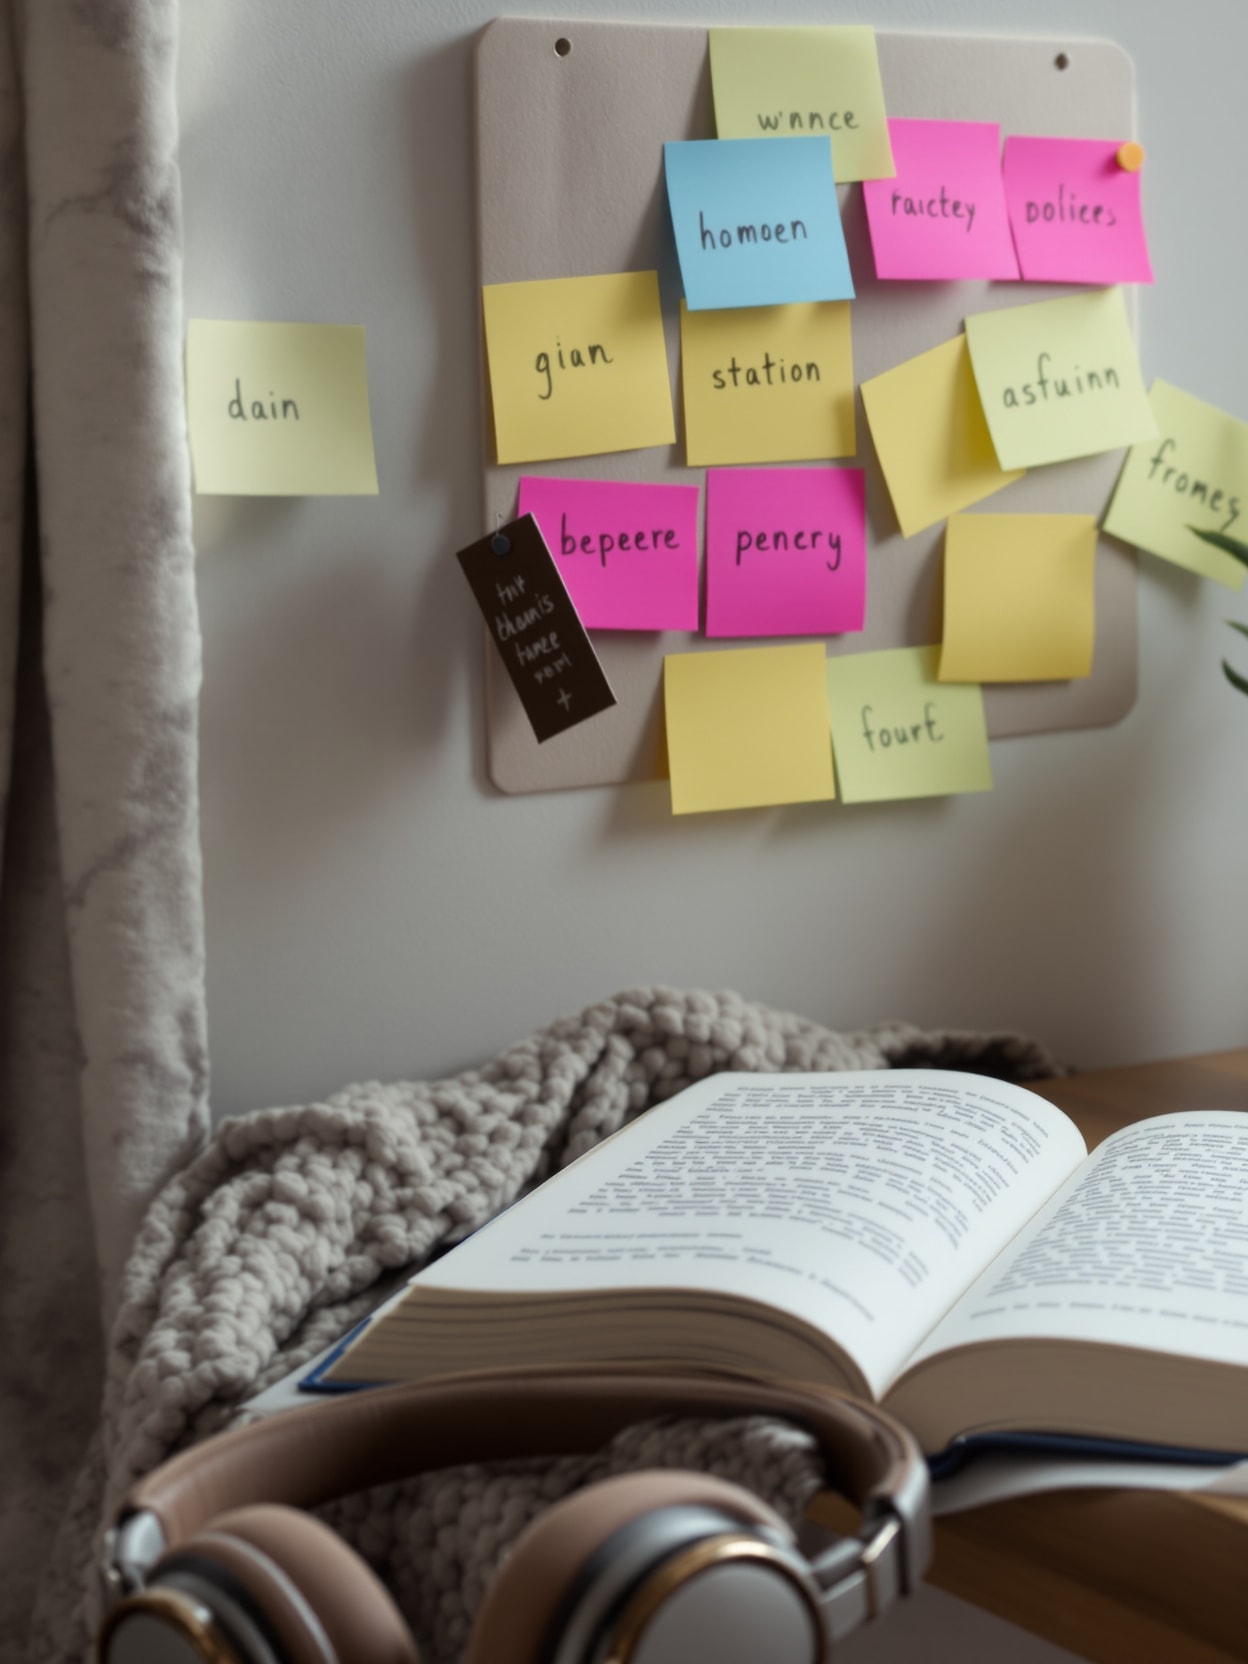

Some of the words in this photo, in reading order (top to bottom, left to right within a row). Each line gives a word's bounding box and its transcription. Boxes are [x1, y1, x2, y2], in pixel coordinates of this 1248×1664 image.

[699, 210, 807, 250] homoen
[535, 341, 614, 400] gian
[712, 352, 821, 389] station
[228, 378, 300, 421] dain
[561, 512, 680, 567] bepeere
